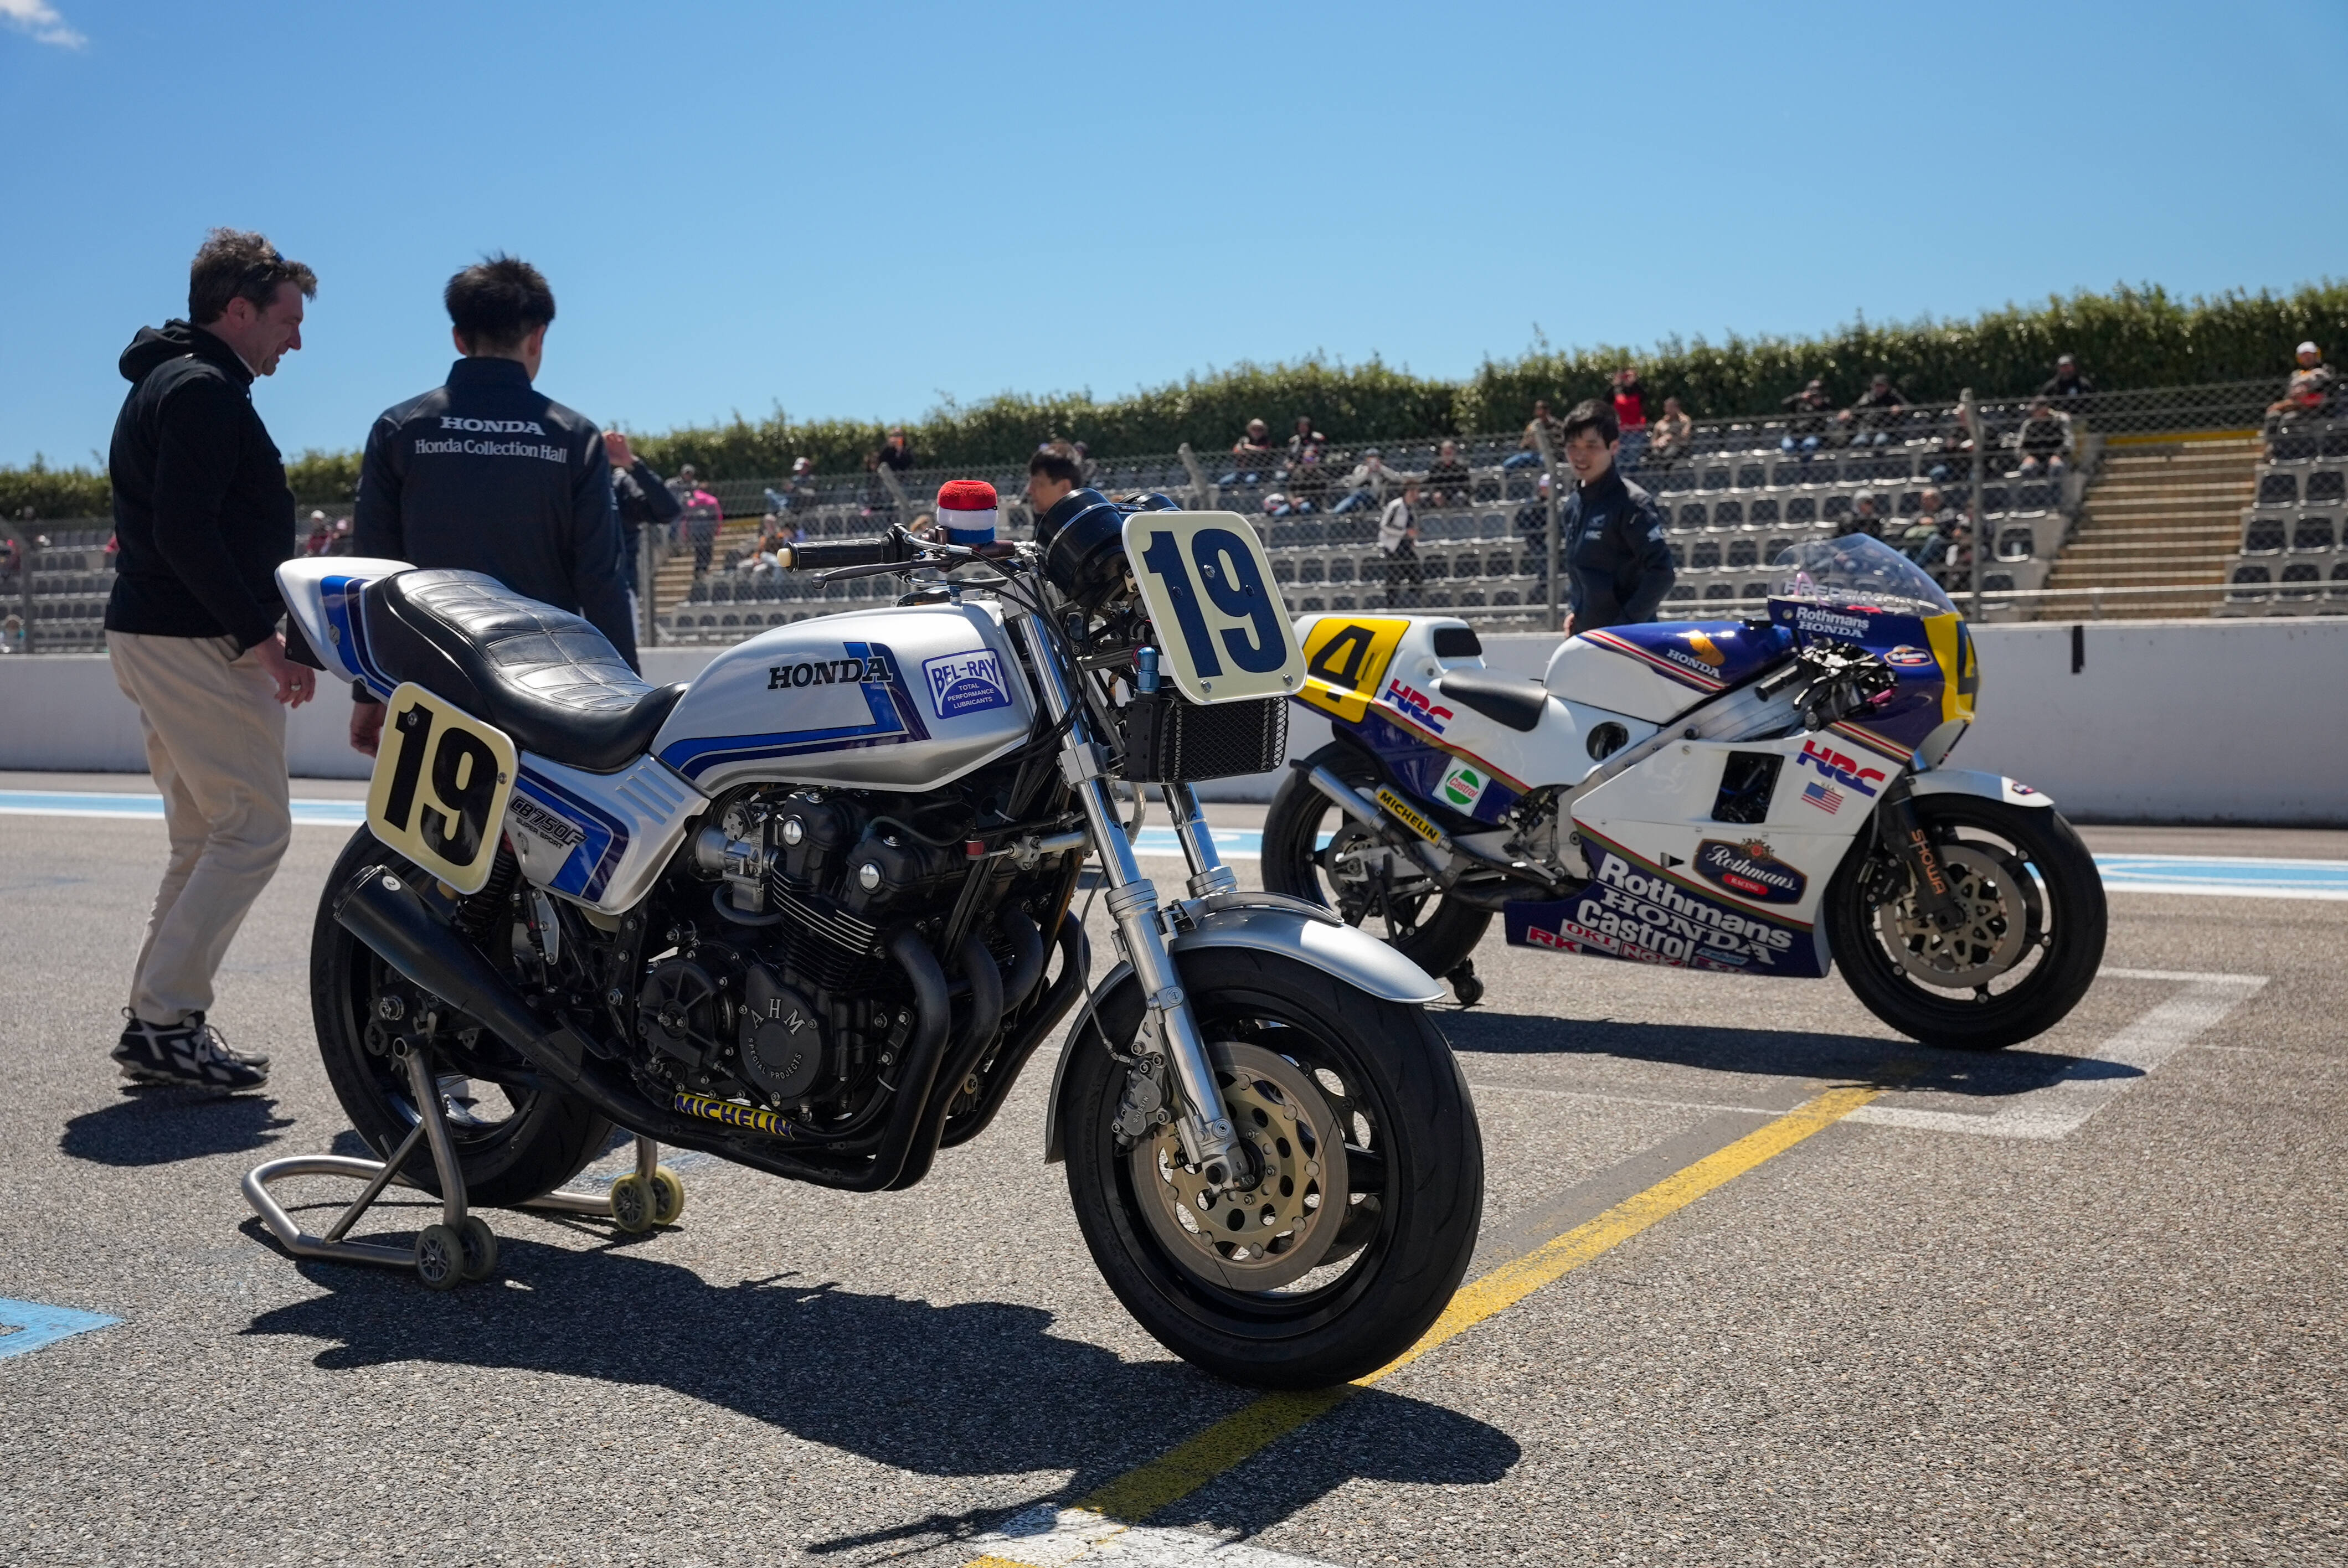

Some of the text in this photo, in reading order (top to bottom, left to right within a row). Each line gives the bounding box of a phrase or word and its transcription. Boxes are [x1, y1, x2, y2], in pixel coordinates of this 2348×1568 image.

[440, 416, 546, 436] HONDA
[415, 439, 568, 464] Honda Collection Hall
[1143, 528, 1288, 679] 19
[1796, 606, 1870, 630] Rothmans
[1798, 621, 1865, 638] HONDA
[767, 656, 894, 690] HONDA
[931, 658, 1000, 699] BEL-RAY
[1307, 624, 1377, 704] 4
[1666, 648, 1721, 679] HONDA
[947, 688, 995, 702] PERFORMANCE
[953, 696, 993, 709] LUBRICANTS
[957, 683, 980, 691] TOTAL
[1384, 678, 1454, 735] HRC
[383, 701, 498, 867] 19
[1449, 777, 1479, 798] Castrol
[1797, 739, 1886, 798] HRC
[516, 817, 564, 850] SUPER SPORT
[1378, 791, 1439, 841] MICHELIN
[1706, 845, 1798, 891] Rothmans
[1911, 829, 1947, 895] SHOWA
[1597, 853, 1794, 949] Rothmans
[1529, 927, 1578, 952] RK
[1577, 899, 1696, 964] Castrol
[1599, 887, 1776, 965] HONDA
[751, 998, 806, 1036] AHM
[748, 1038, 802, 1080] SPECIAL PROJECTS
[676, 1094, 792, 1136] MICHELIN
[1135, 1095, 1149, 1119] NISSIN
